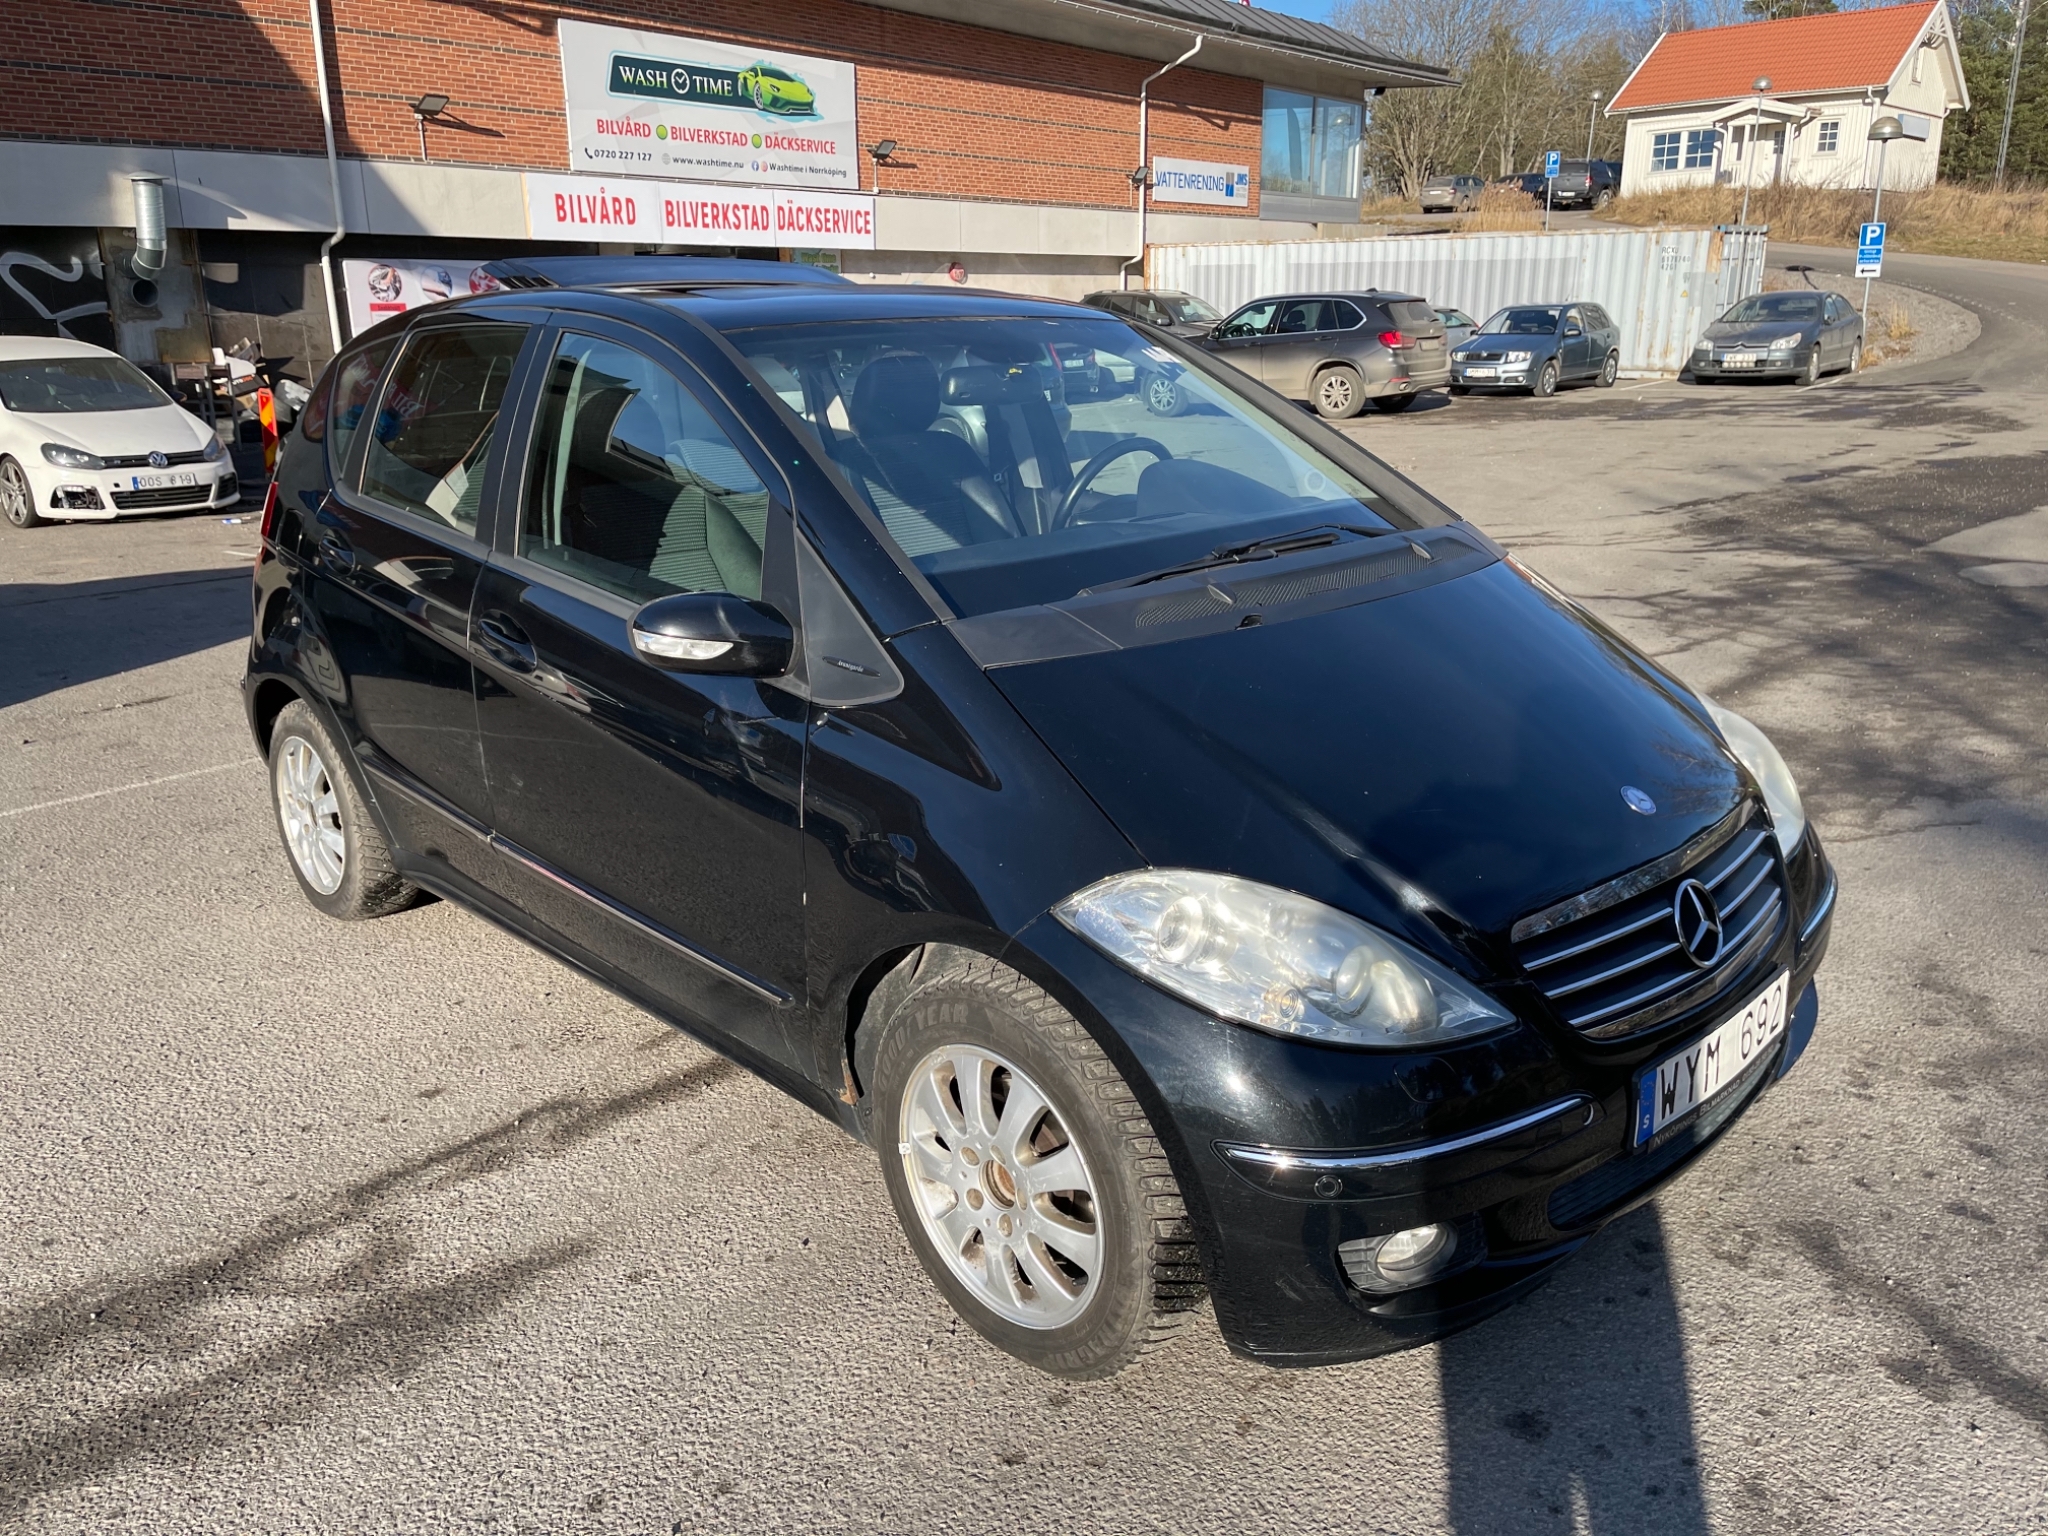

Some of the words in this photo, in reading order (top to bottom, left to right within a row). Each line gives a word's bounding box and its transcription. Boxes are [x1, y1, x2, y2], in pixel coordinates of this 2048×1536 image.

[618, 65, 668, 89] WASH
[692, 75, 734, 97] TIME
[596, 115, 652, 138] BILVÅRD
[670, 126, 749, 147] BILVERKSTAD
[764, 132, 836, 155] DÄCKSERVICE
[593, 149, 617, 159] 0720
[618, 150, 634, 160] 227
[637, 152, 652, 162] 127
[672, 156, 744, 169] www.washtime.nu
[769, 162, 804, 174] Washtime
[1550, 153, 1558, 166] P
[1155, 170, 1225, 192] VATTENRENING
[554, 186, 637, 226] BILVÅRD
[664, 199, 770, 232] BILVERKSTAD
[776, 199, 872, 236] DÄCKSERVICE
[1865, 225, 1881, 246] P
[1660, 1035, 1722, 1121] WYM
[1740, 984, 1782, 1061] 692
